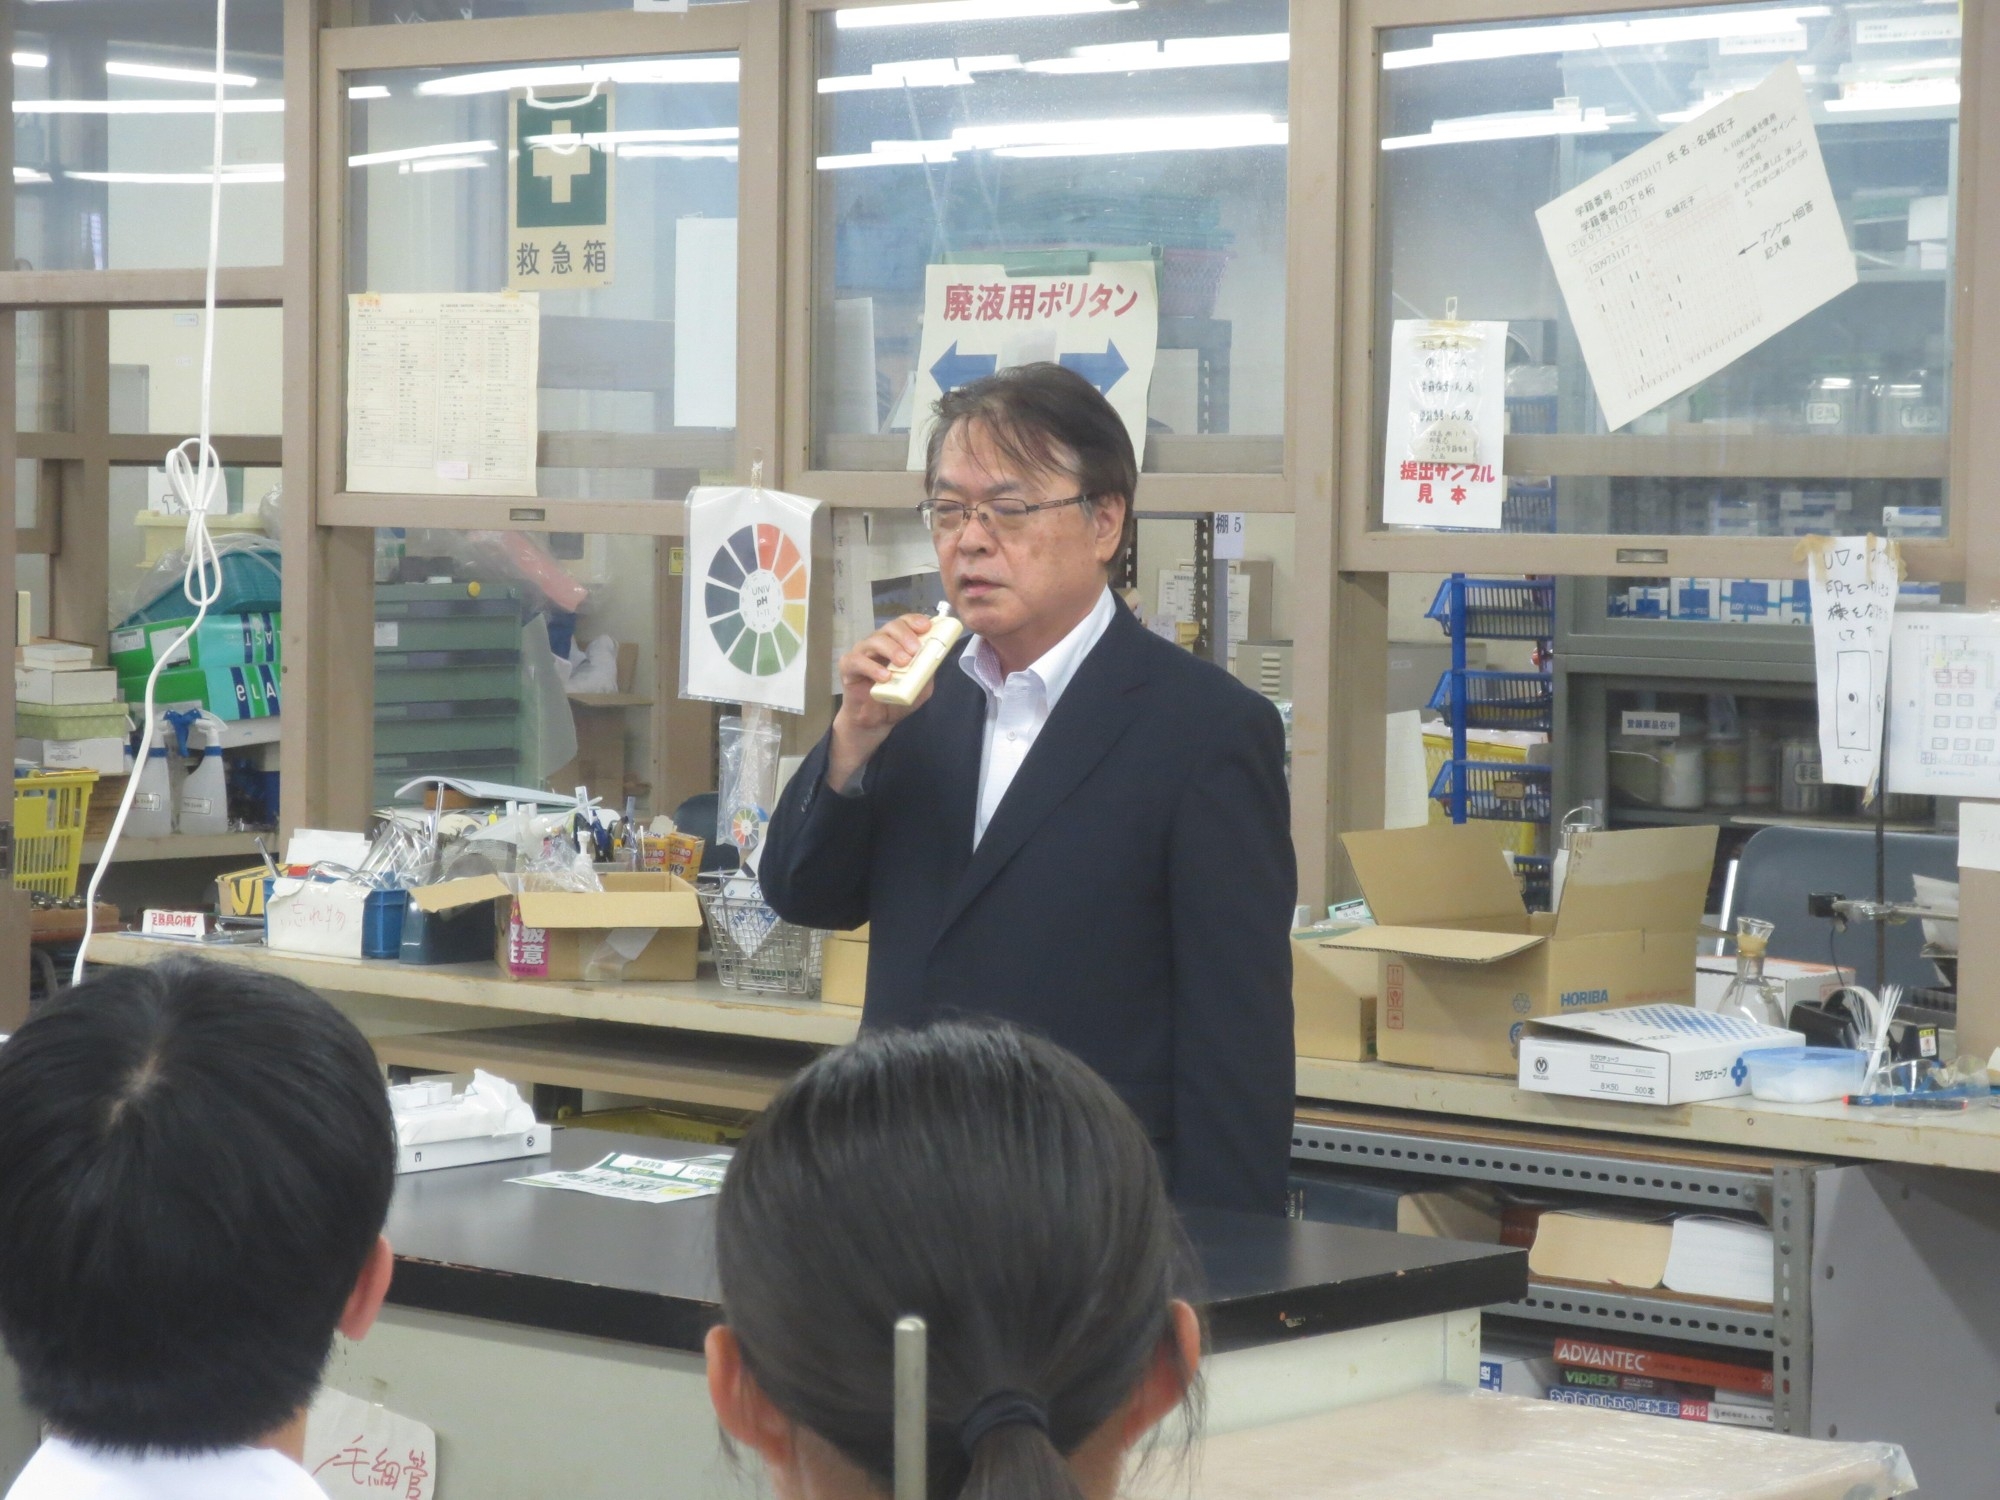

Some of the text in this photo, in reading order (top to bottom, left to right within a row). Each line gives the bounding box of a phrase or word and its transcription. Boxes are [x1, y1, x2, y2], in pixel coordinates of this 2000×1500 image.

[1761, 199, 1814, 244] アンケート回答
[516, 239, 607, 276] 救急箱
[943, 281, 1138, 322] 廃液用ポリタン
[1400, 460, 1496, 482] 提出サンプル
[751, 584, 771, 596] UNIV
[756, 596, 768, 608] pH
[1560, 989, 1609, 1007] HORIBA
[1695, 1067, 1728, 1082] ミクロチューブ
[1558, 1342, 1646, 1372] ADVANTEC
[1564, 1370, 1618, 1388] VIDREX
[1681, 1404, 1707, 1418] 2012
[312, 1434, 428, 1500] 毛細管
